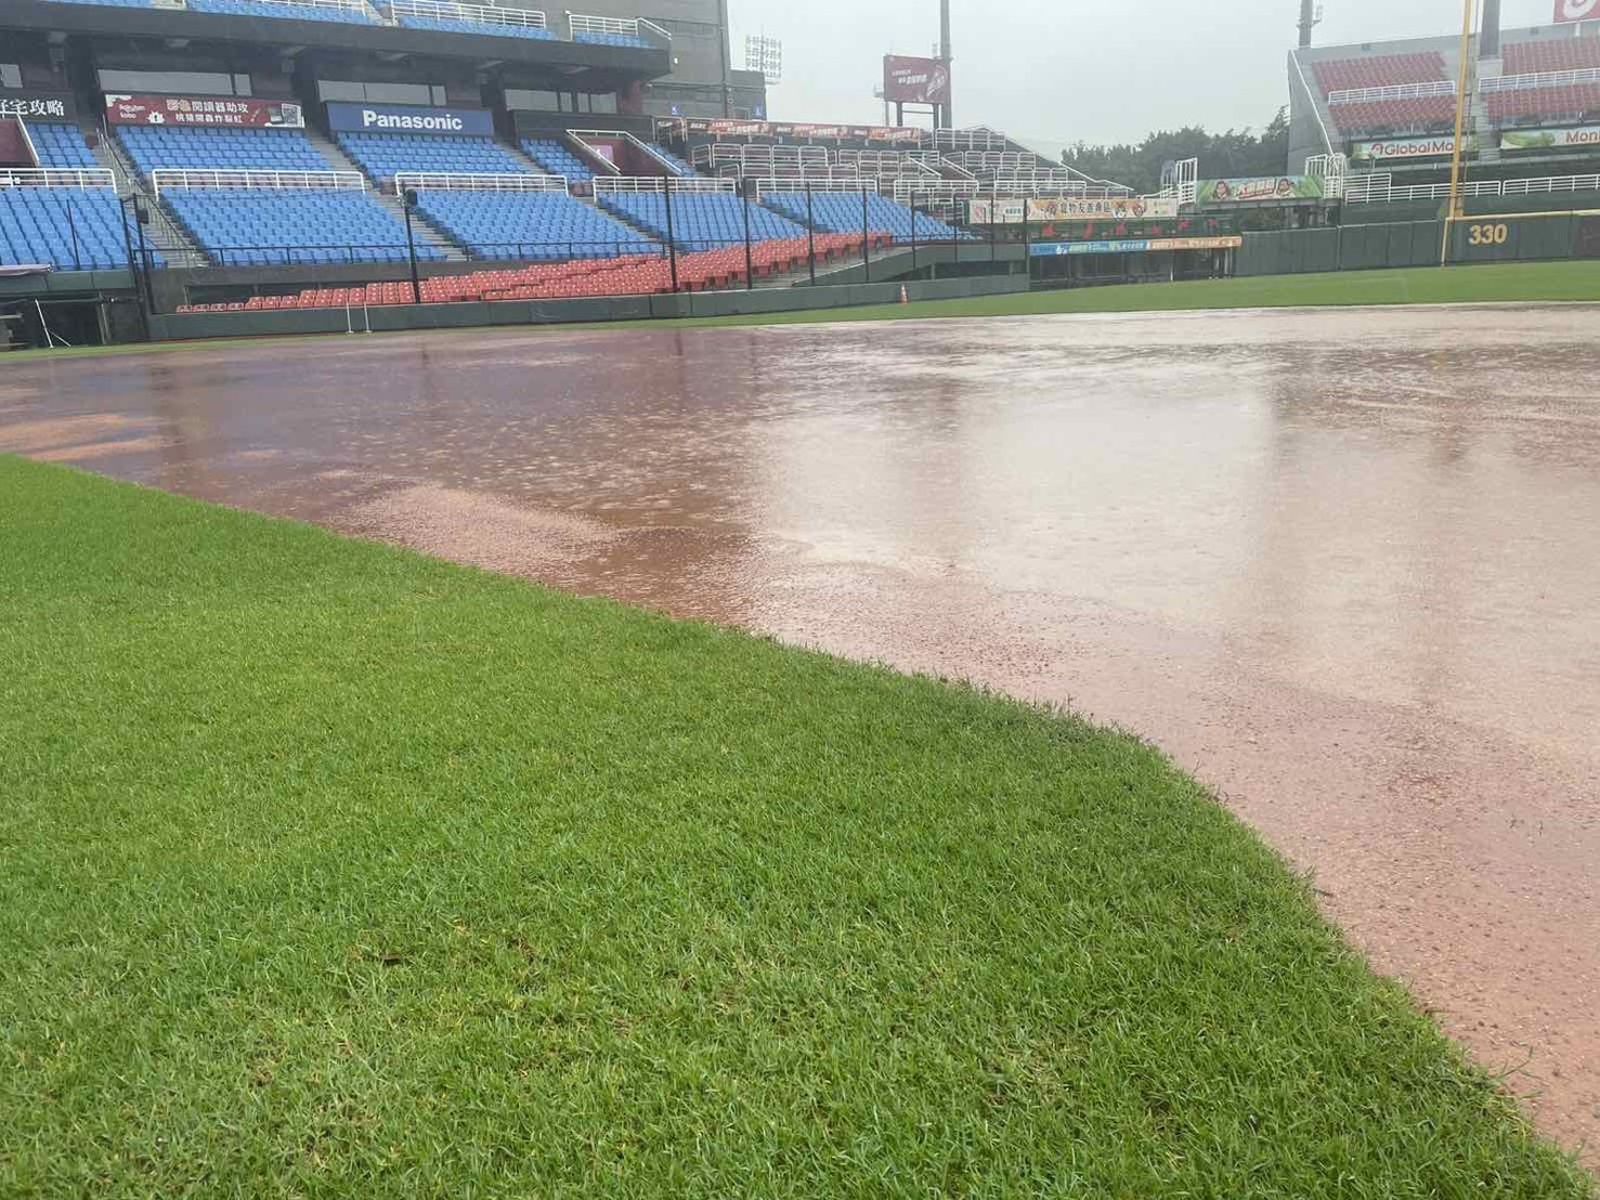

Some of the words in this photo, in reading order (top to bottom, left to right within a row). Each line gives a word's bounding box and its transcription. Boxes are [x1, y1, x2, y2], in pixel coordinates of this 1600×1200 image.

[362, 109, 464, 131] Panasonic
[1566, 130, 1600, 143] Mon
[1469, 224, 1507, 245] 330
